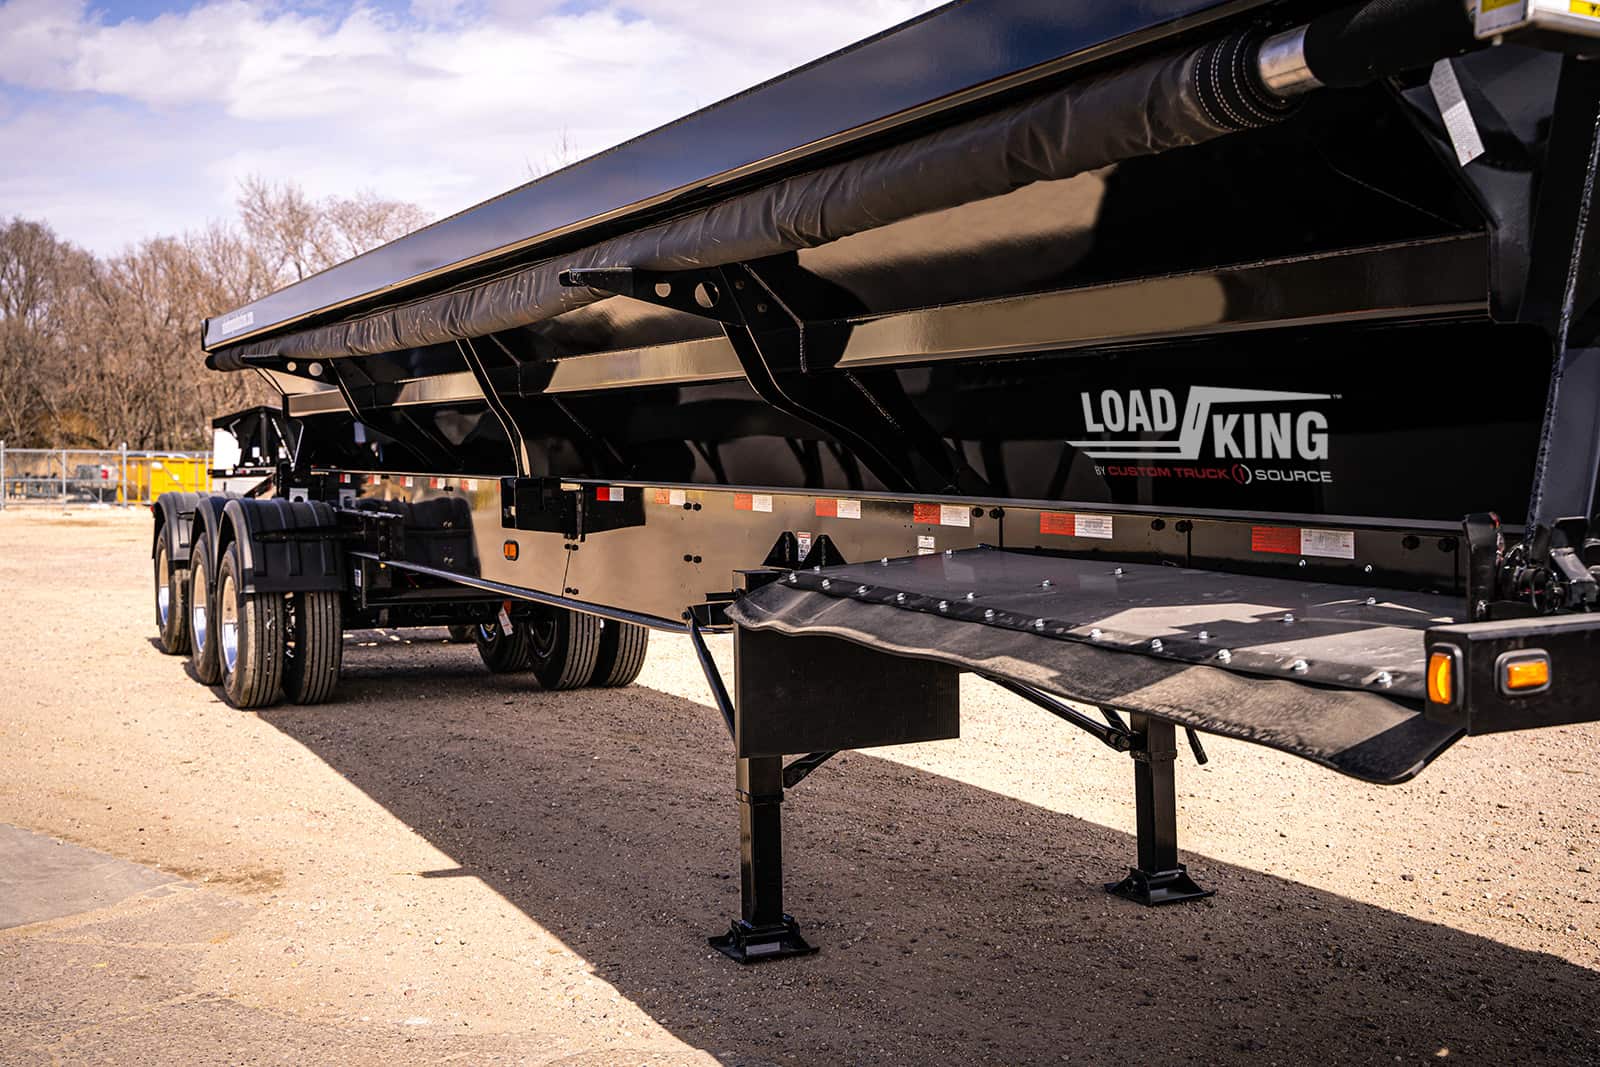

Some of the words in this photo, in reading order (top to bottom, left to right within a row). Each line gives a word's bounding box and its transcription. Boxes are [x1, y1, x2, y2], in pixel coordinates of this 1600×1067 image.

[1081, 388, 1177, 433] LOAD
[1212, 411, 1329, 460] KING
[1094, 465, 1106, 476] BY
[1107, 465, 1172, 478] CUSTOM
[1173, 467, 1231, 480] TRUCK
[1255, 469, 1334, 483] SOURCE
